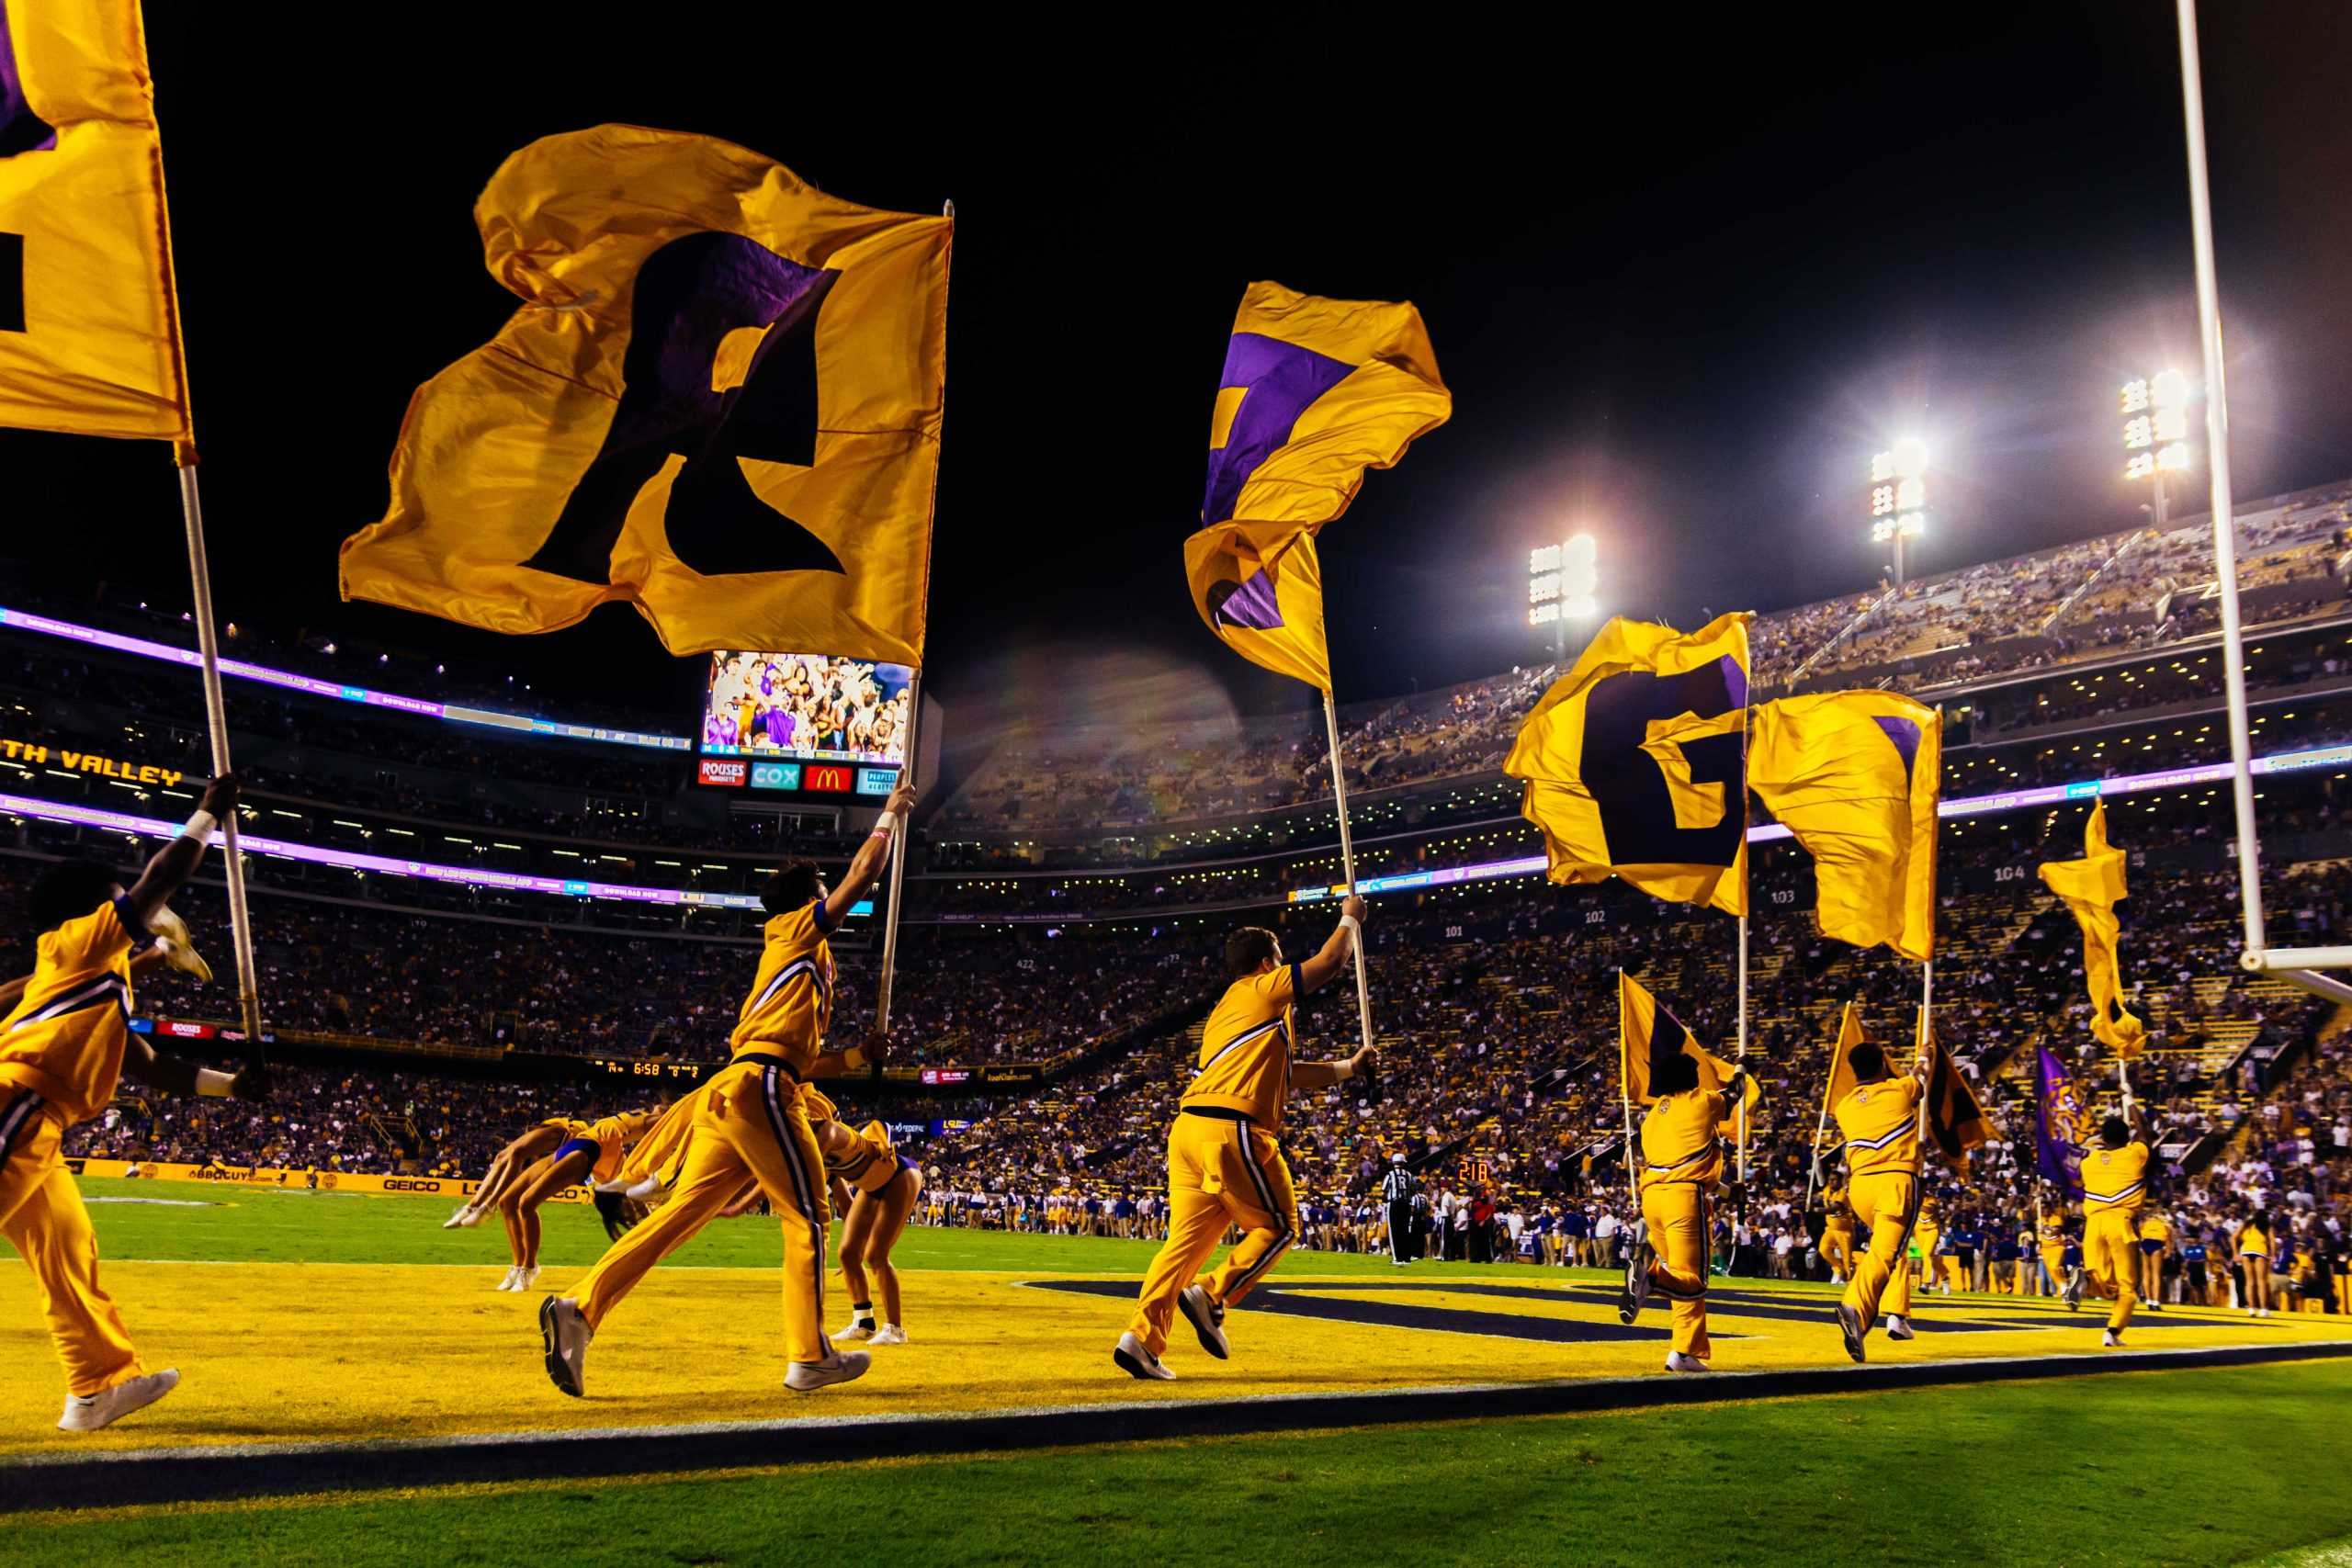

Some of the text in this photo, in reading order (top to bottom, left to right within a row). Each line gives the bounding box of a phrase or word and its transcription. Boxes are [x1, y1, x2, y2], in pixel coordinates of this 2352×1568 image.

[0, 739, 183, 786] TH VALLEY
[702, 761, 744, 777] ROUSES
[753, 767, 797, 784] COX
[2128, 774, 2191, 790] DOWNLOAD
[1994, 865, 2026, 883] 104
[604, 887, 641, 897] DOWNLOAD
[1771, 890, 1795, 904] 103
[1585, 910, 1606, 924] 102
[1444, 926, 1464, 938] 101
[634, 1063, 660, 1075] 6:58
[383, 1179, 440, 1192] GEICO
[1396, 1176, 1408, 1190] R
